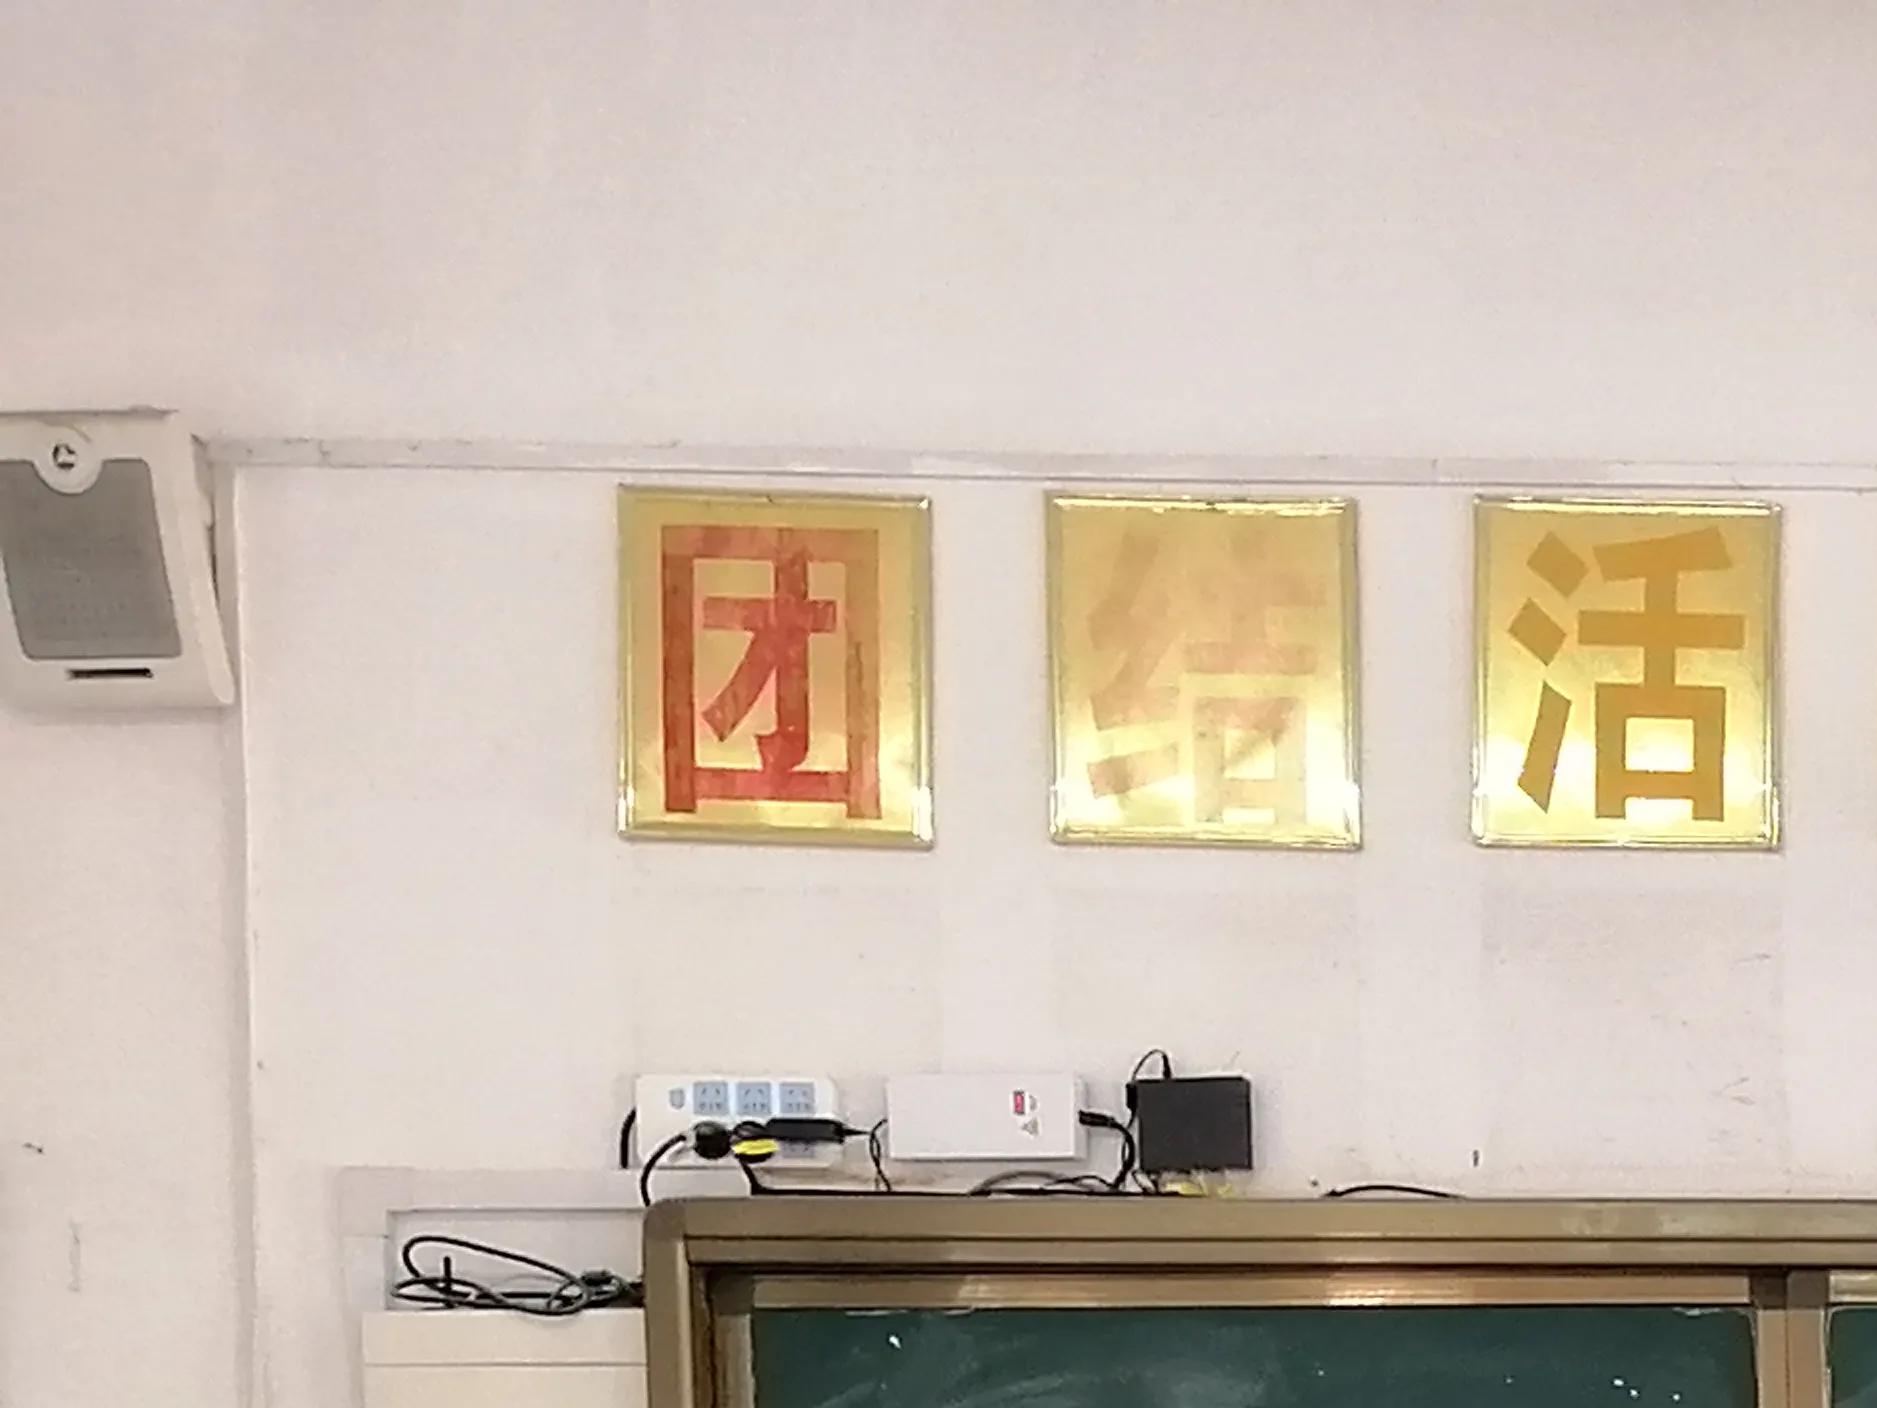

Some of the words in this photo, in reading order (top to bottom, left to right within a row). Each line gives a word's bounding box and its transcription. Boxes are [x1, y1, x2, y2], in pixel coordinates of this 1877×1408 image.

[660, 525, 878, 818] 团
[1086, 528, 1328, 825] 结
[1508, 525, 1745, 821] 活
